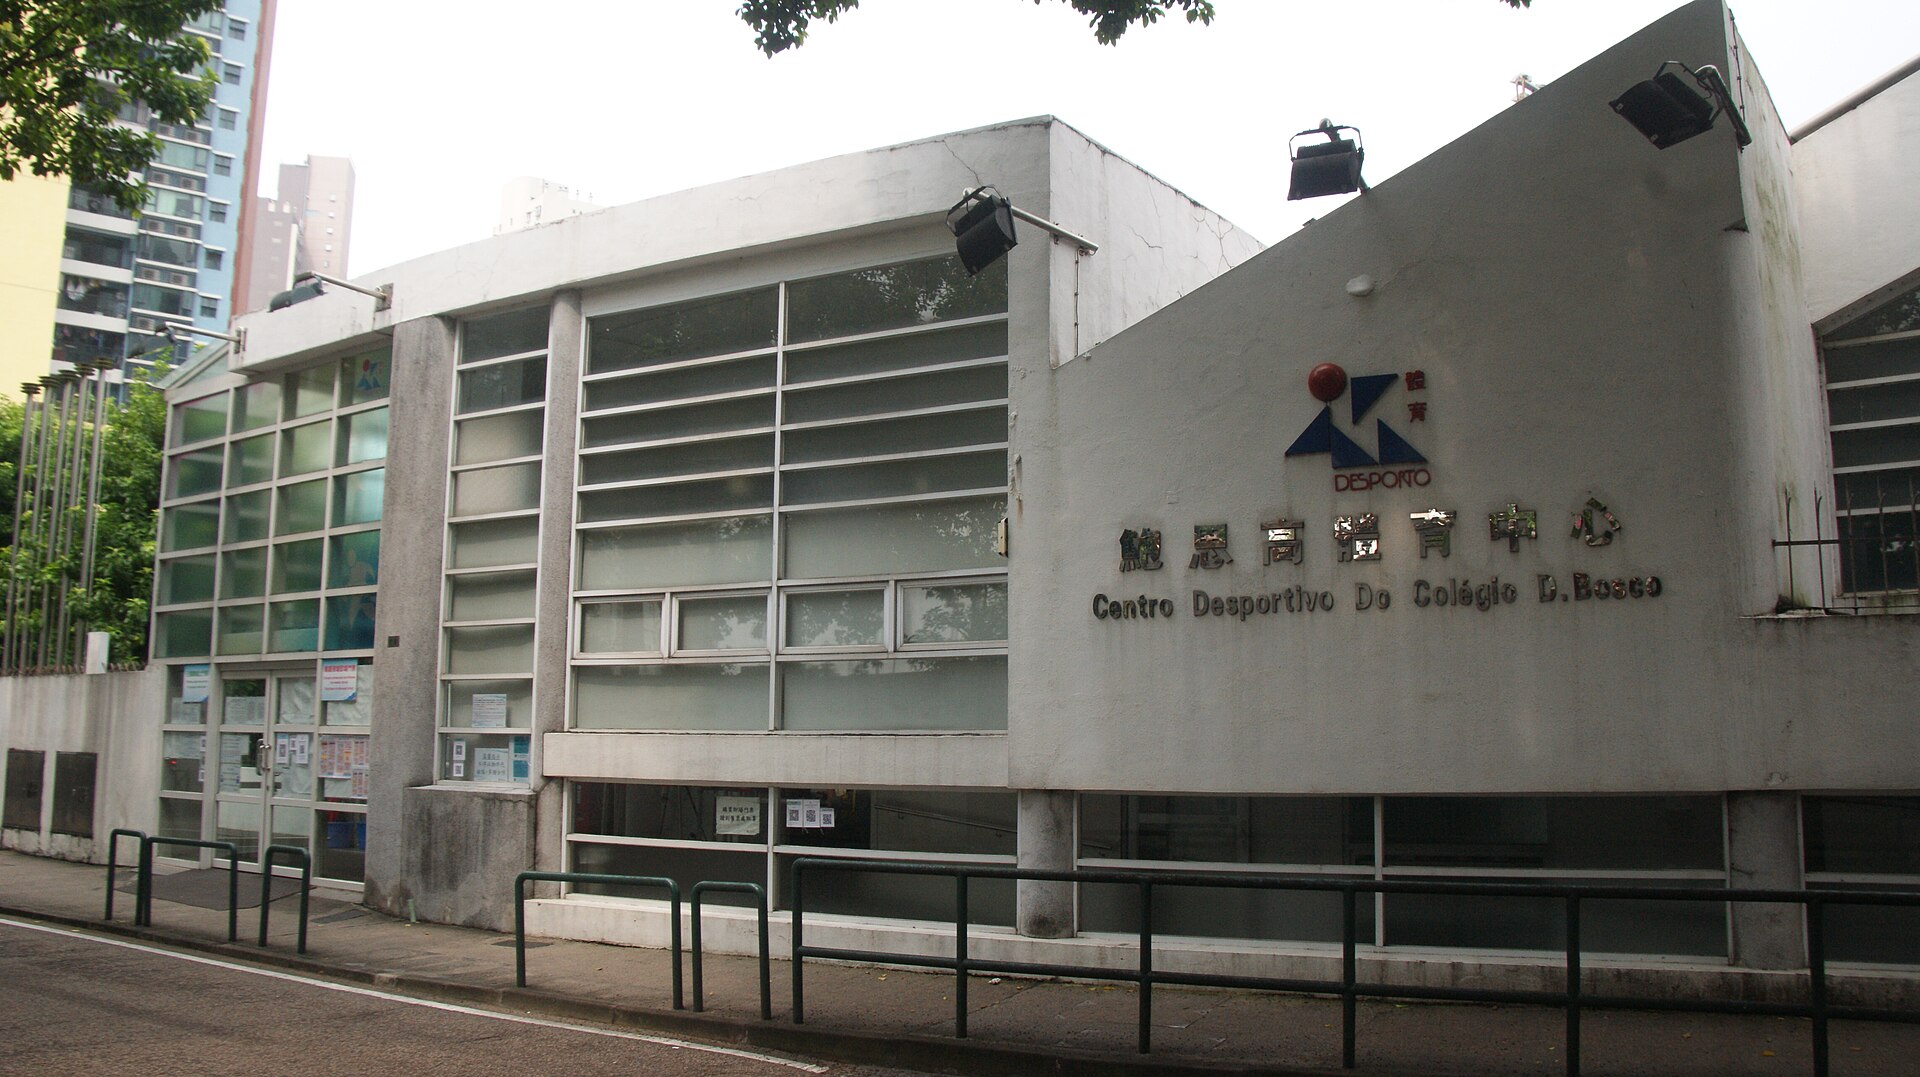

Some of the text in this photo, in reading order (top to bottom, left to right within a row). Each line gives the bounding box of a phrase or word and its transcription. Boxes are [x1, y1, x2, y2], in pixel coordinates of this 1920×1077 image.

[1334, 469, 1431, 492] DESPORTO
[1119, 497, 1622, 572] 鮑思高體育中心
[1093, 593, 1174, 620] Centro
[1193, 585, 1334, 621] Desportivo
[1355, 582, 1390, 611] Do
[1414, 575, 1517, 611] Colégio
